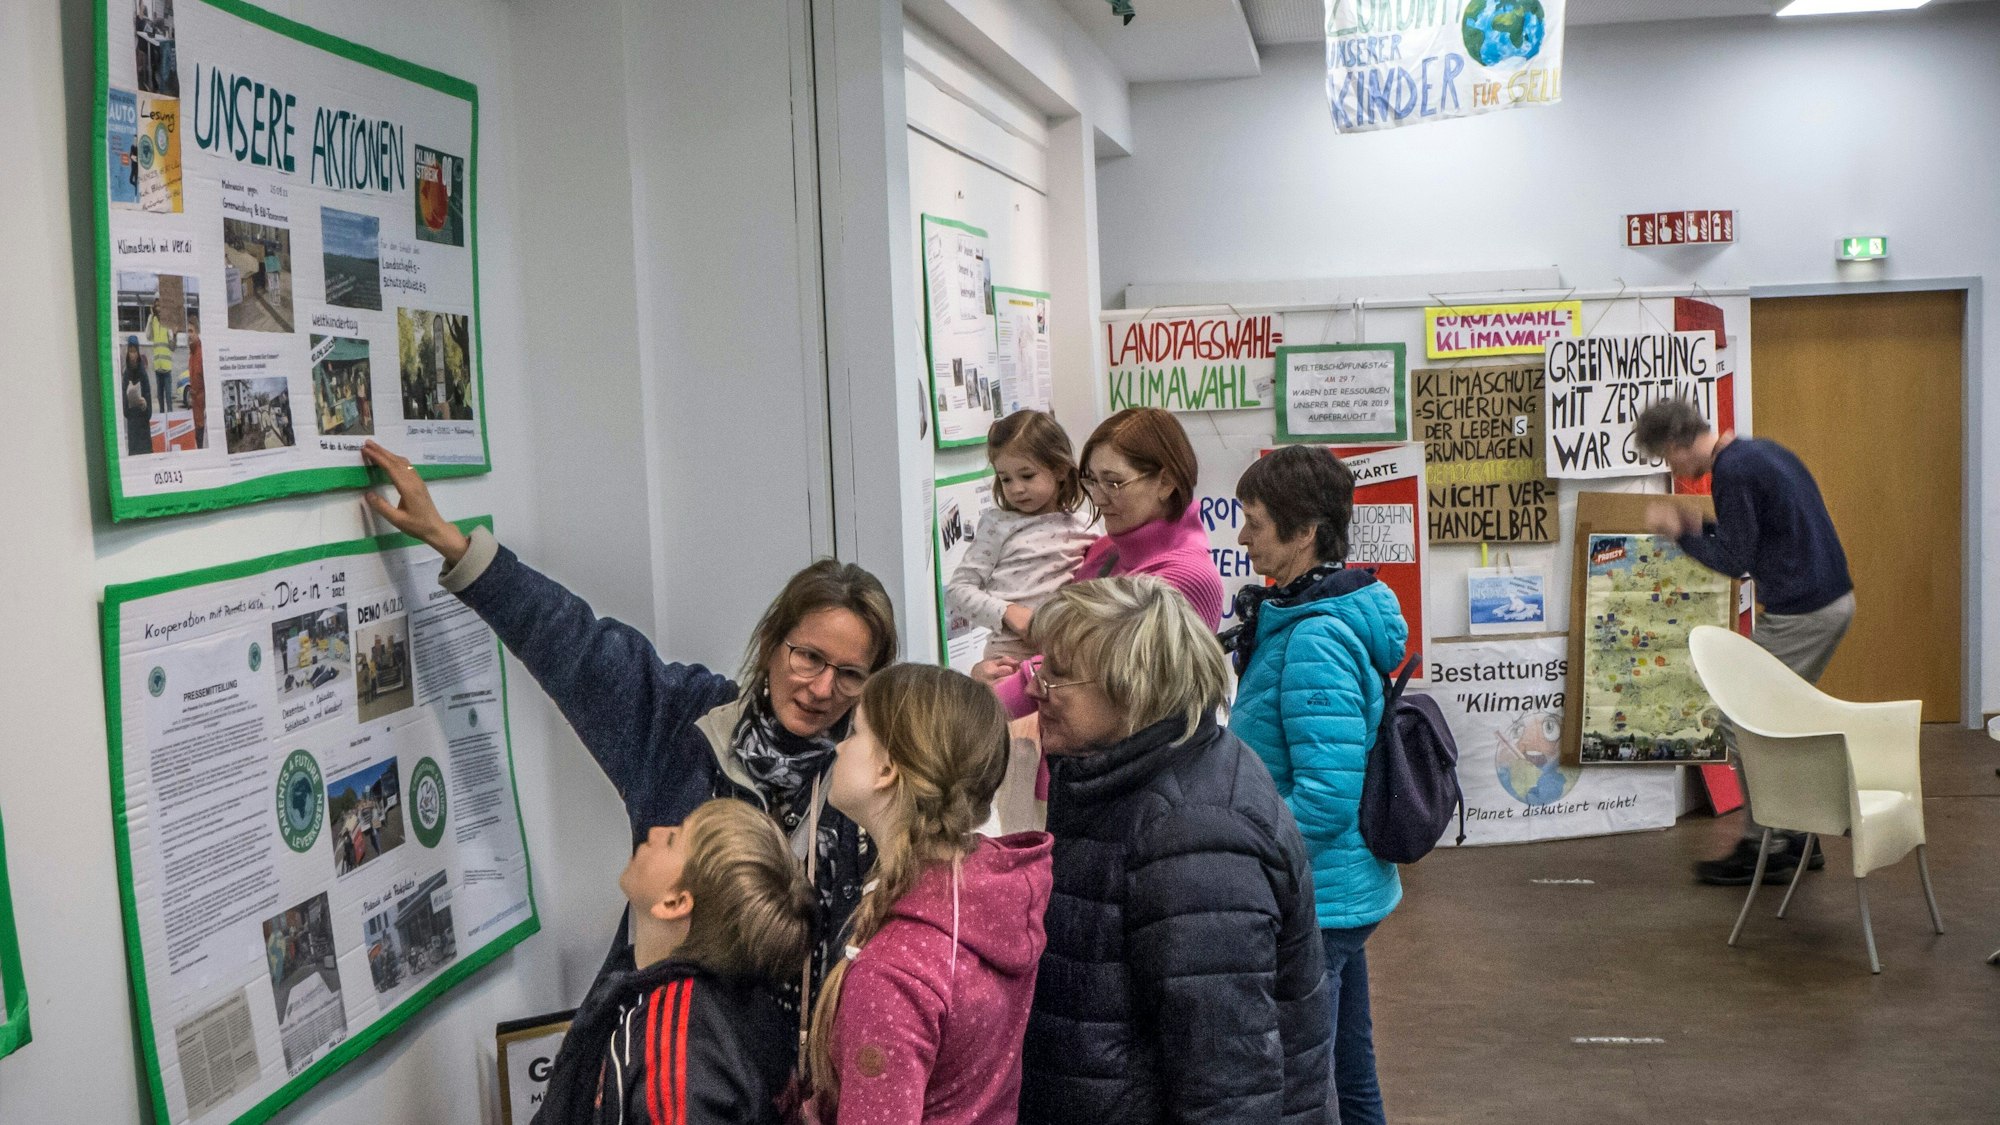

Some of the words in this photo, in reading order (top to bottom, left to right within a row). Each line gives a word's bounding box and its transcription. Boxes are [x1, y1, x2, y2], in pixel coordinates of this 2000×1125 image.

[1326, 35, 1402, 69] UNSERER
[1328, 53, 1465, 129] KINDER
[1473, 79, 1502, 107] FÜR
[109, 103, 135, 124] AUTO
[141, 101, 175, 133] Lesung
[194, 63, 296, 172] UNSERE
[416, 149, 437, 166] KLIMA
[416, 164, 439, 182] STREIK
[117, 237, 156, 254] Klimastreik
[1293, 361, 1389, 373] WELTERSCHÖPFUNGSTAG
[1292, 388, 1321, 397] WAREN
[1324, 388, 1337, 396] DIE
[1340, 387, 1390, 396] RESSOURCEN
[1293, 401, 1328, 409] UNSERER
[1332, 400, 1350, 408] ERDE
[1353, 399, 1368, 408] FÜR
[1308, 412, 1368, 421] AUFGEBRAUCHT
[1425, 422, 1452, 440] DER
[1460, 417, 1534, 440] LEBENS-
[1425, 438, 1533, 462] GRUNDLAGEN
[1553, 431, 1611, 472] WAR
[1353, 463, 1398, 480] KARTE
[1351, 505, 1412, 525] UTOBAHN
[1428, 507, 1548, 540] HANDELBAR
[1352, 525, 1392, 544] REUZ
[1347, 543, 1415, 563] EVERKUSEN
[145, 611, 206, 641] Kooperation
[209, 606, 222, 620] mit
[358, 602, 380, 625] DEMO
[183, 680, 238, 702] PRESSEMITTEILUNG
[277, 769, 290, 837] PARENTS
[294, 755, 320, 785] FUTURE
[1466, 807, 1513, 821] Planet
[1522, 799, 1589, 817] diskutiert
[1597, 794, 1638, 811] nicht!
[292, 793, 323, 849] LEVERKUSEN
